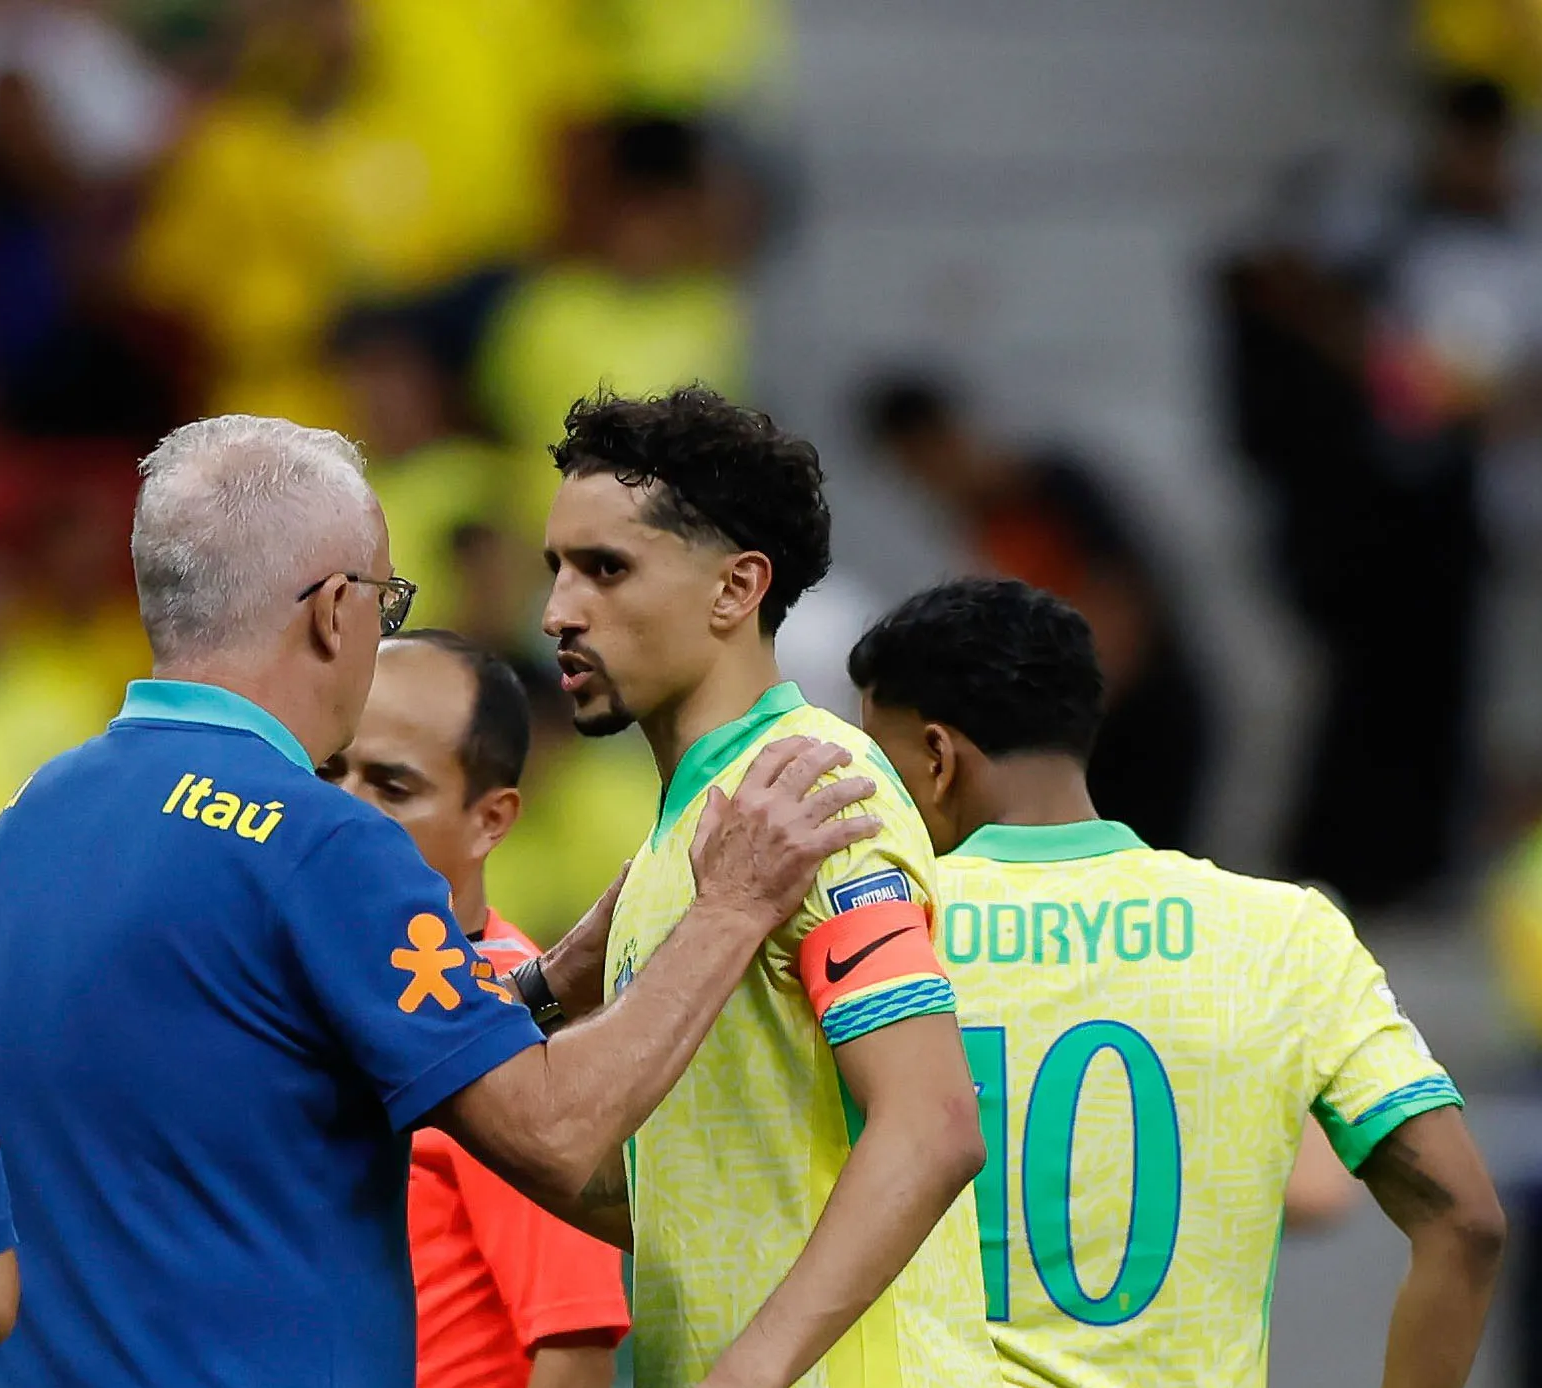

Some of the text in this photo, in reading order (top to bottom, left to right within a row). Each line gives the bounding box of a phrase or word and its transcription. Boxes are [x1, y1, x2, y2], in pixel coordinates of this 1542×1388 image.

[162, 772, 285, 844] Itaú
[945, 896, 1195, 965] ODRYGO
[960, 1019, 1182, 1327] 10
